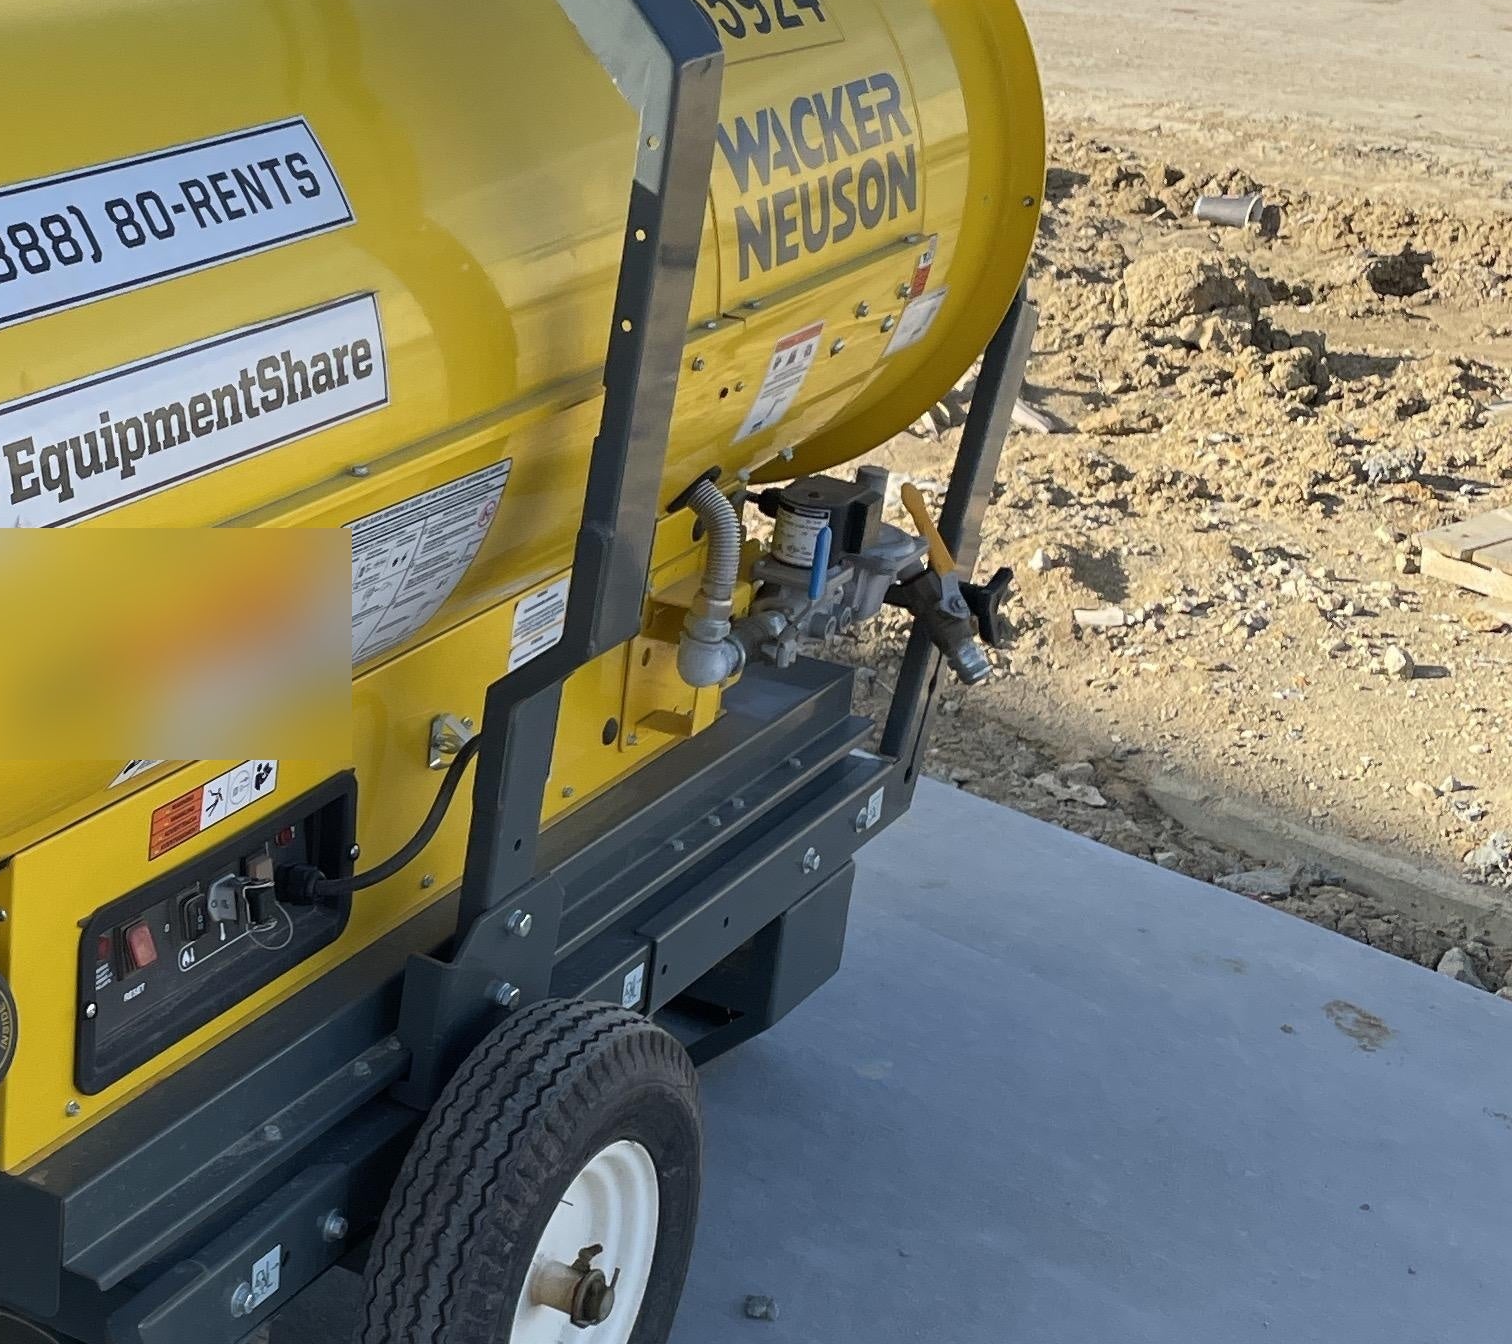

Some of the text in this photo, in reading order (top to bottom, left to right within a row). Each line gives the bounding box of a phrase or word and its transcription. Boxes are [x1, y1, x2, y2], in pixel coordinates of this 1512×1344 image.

[717, 71, 914, 194] WACKER
[104, 151, 322, 248] 80-RENTS
[733, 144, 918, 281] NEUSON
[1, 336, 375, 503] EquipmentShare
